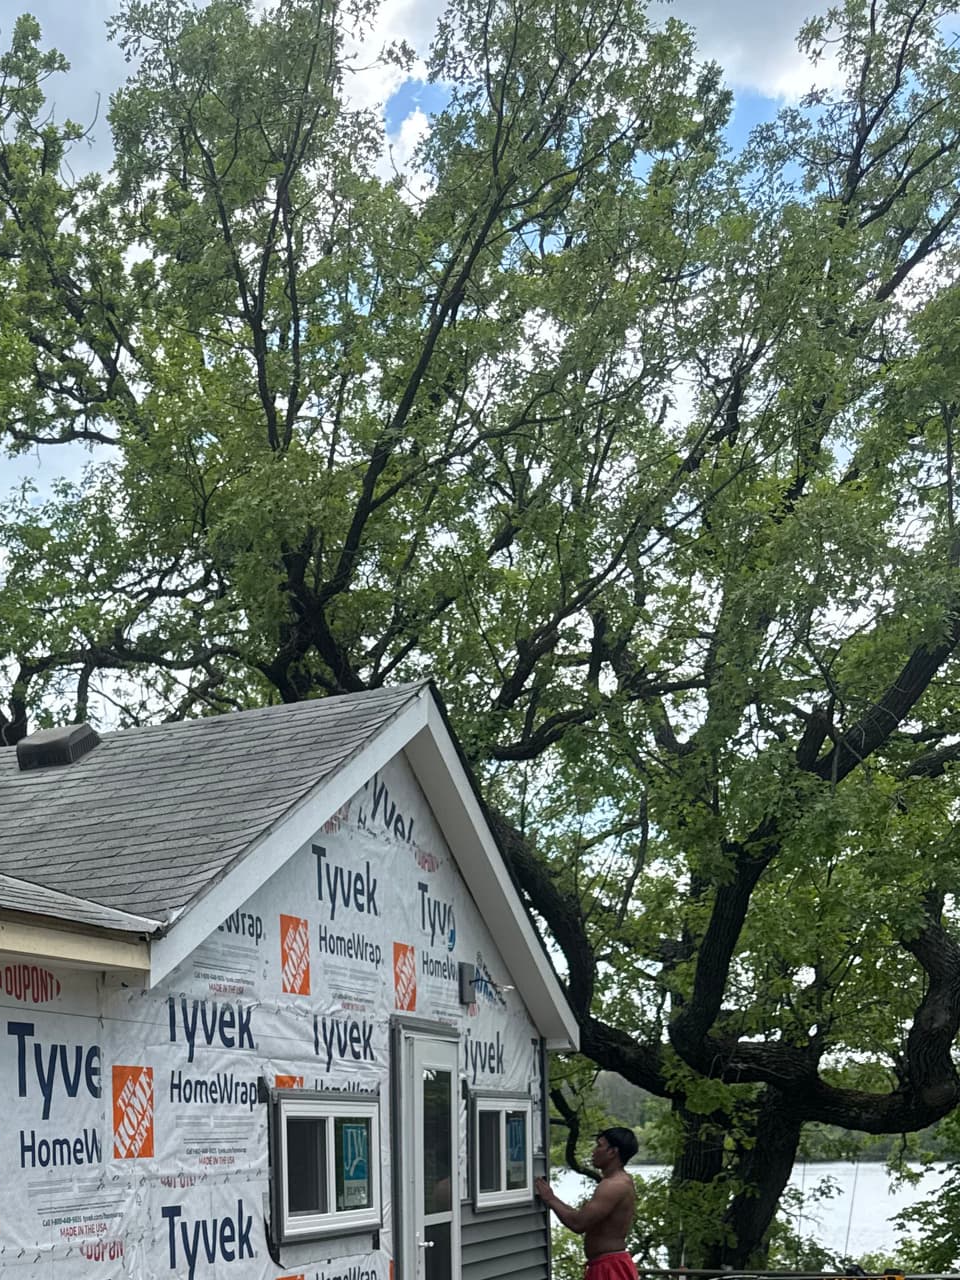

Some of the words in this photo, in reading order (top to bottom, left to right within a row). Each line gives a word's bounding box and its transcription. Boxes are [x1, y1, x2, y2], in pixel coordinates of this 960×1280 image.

[311, 844, 378, 920] Tyvek
[319, 924, 382, 970] HomeWrap
[4, 963, 54, 1003] DUPONT
[7, 1021, 102, 1120] Tyve
[170, 1070, 258, 1112] HomeWrap
[20, 1128, 102, 1168] HomeW
